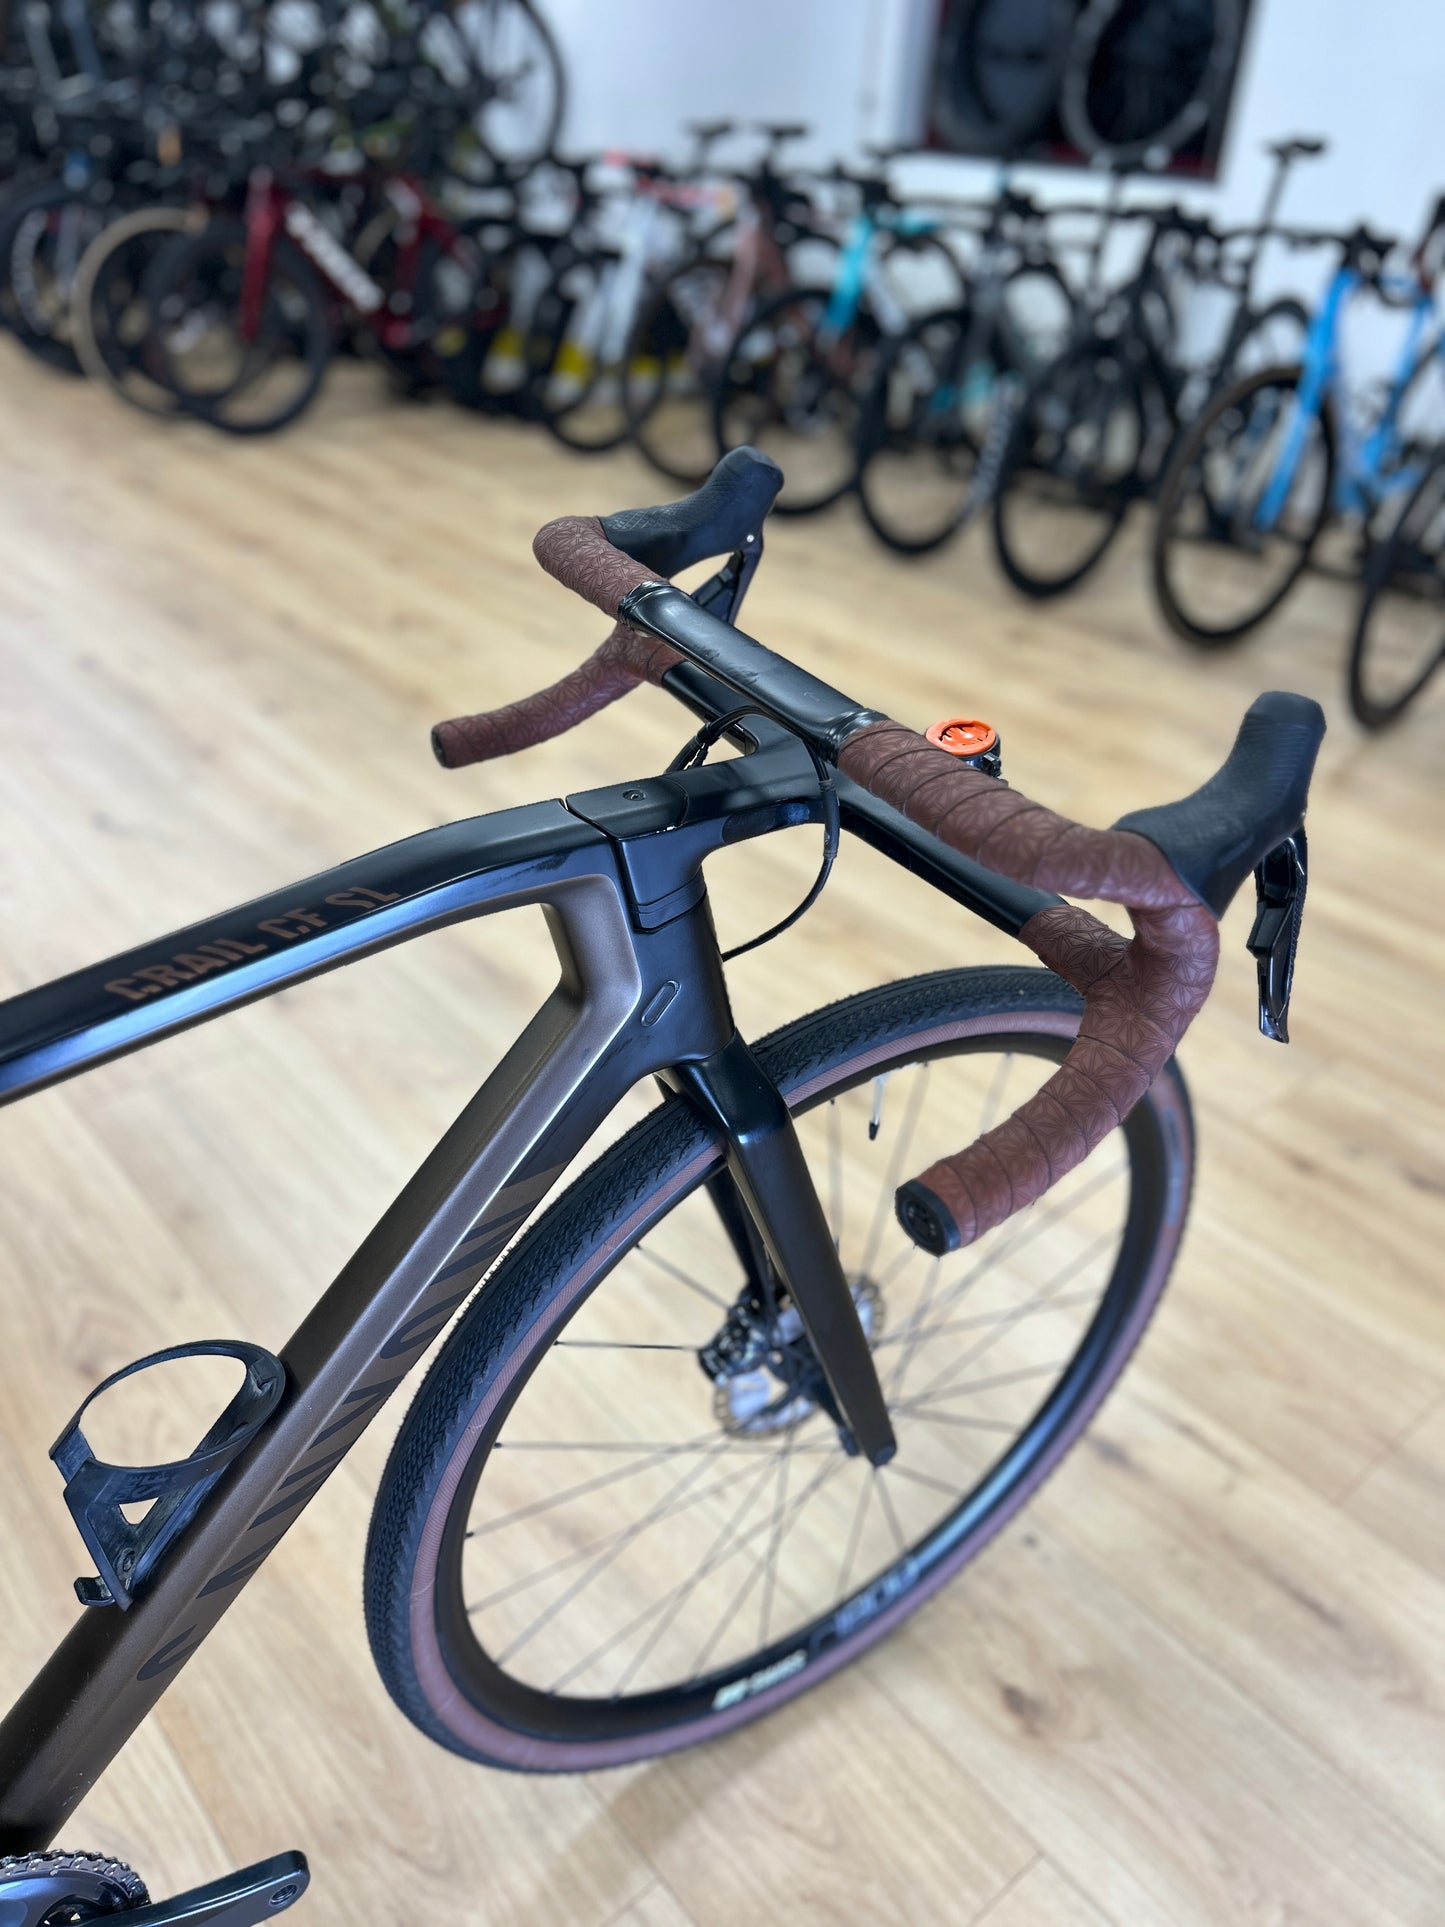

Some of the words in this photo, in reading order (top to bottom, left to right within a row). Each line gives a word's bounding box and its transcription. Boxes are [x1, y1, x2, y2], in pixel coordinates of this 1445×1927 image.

[103, 938, 268, 1000] GRAIL
[257, 907, 328, 939] CF
[325, 886, 400, 909] SL
